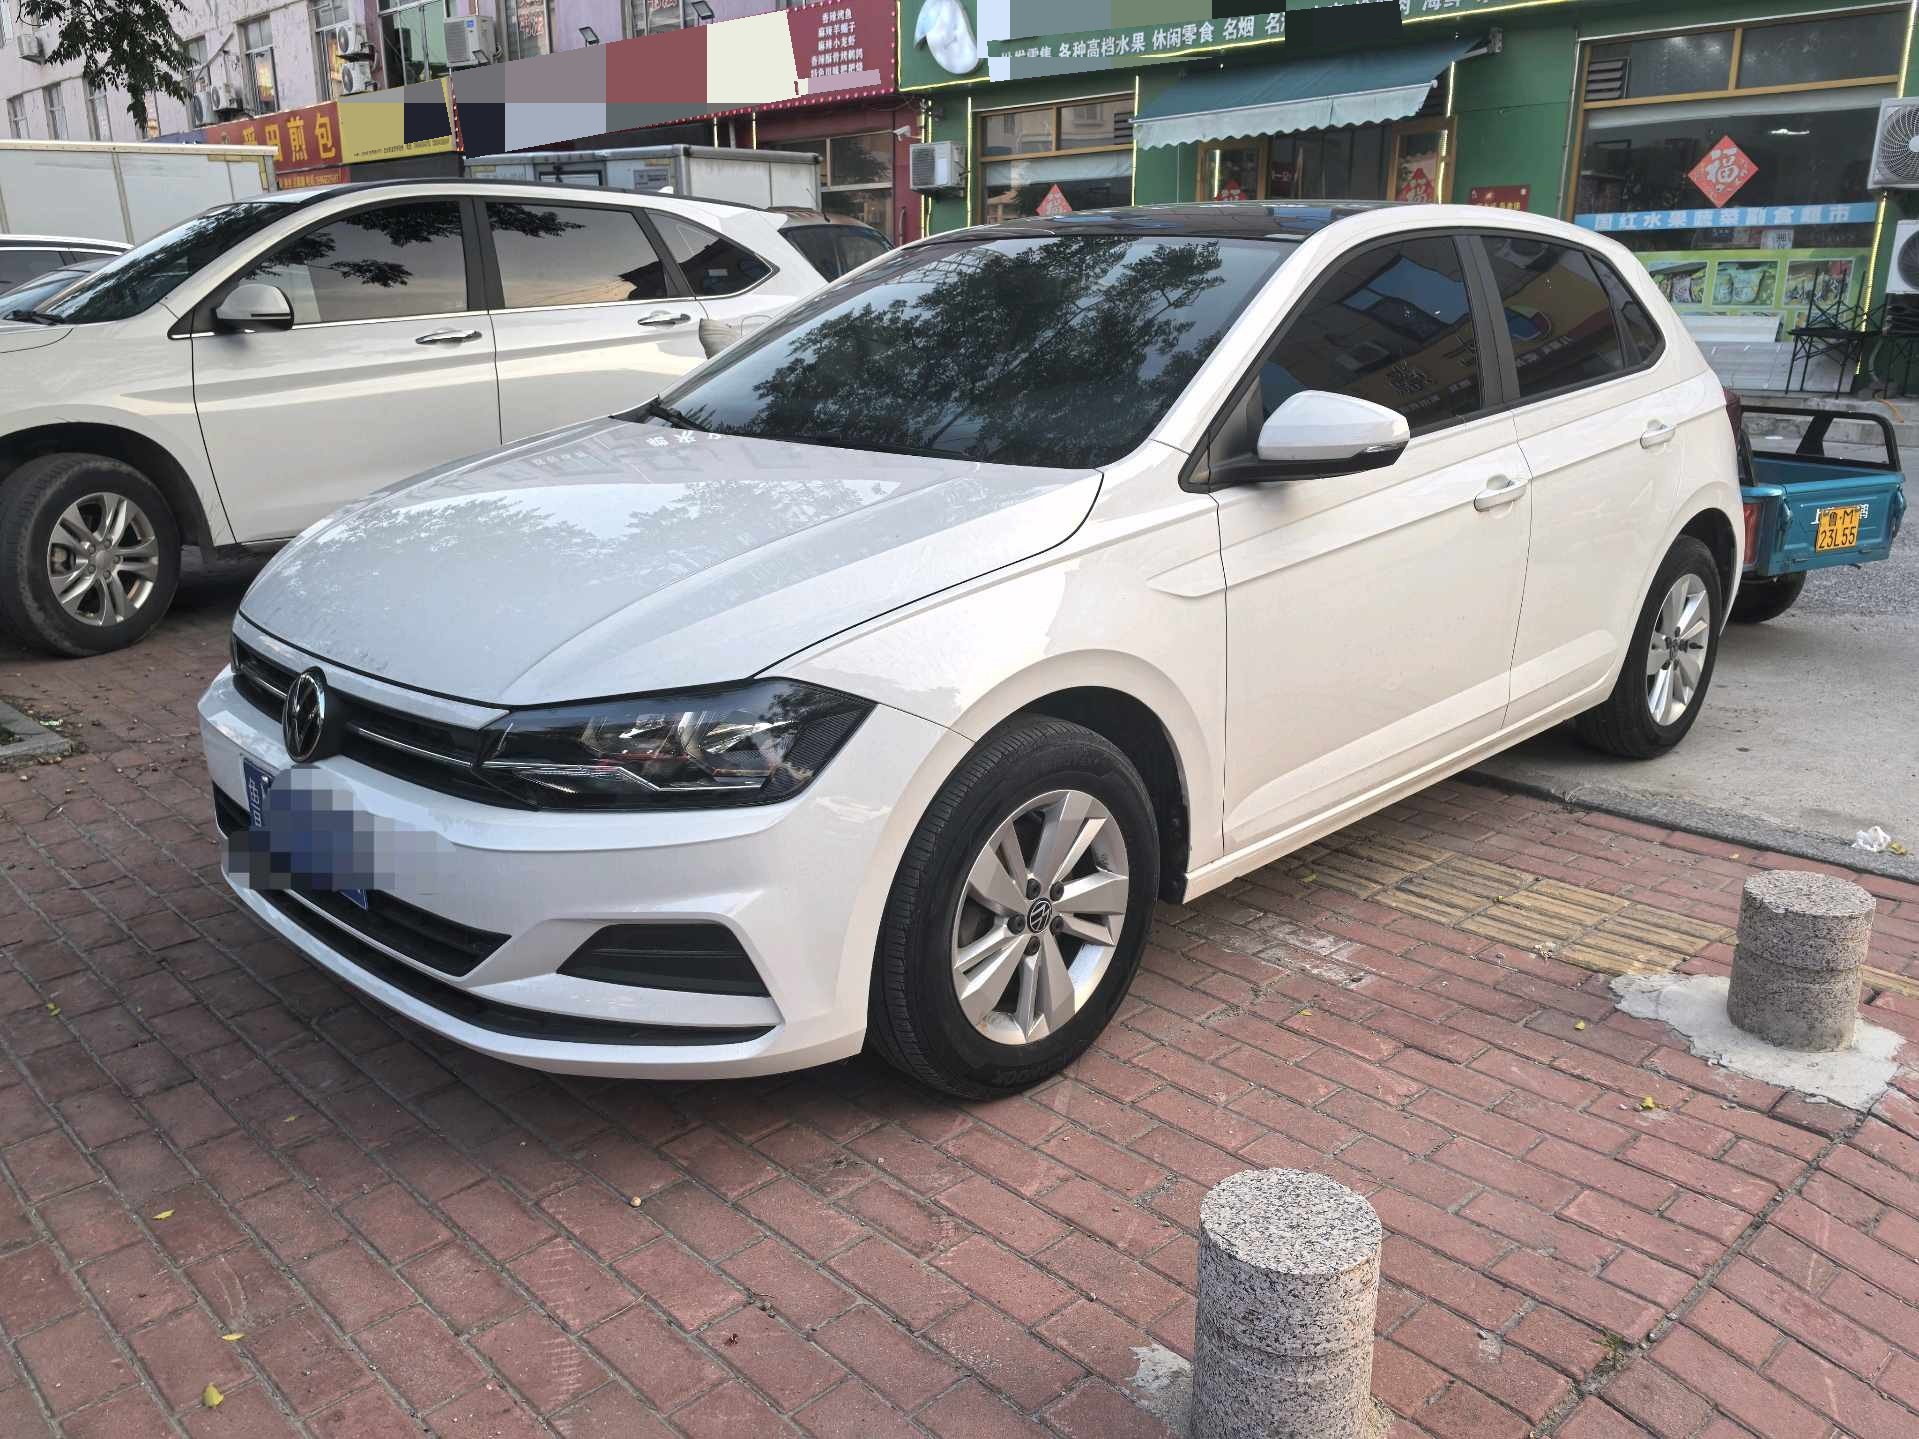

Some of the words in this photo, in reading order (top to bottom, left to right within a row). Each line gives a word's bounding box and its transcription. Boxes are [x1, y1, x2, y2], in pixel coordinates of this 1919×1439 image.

[818, 35, 855, 51] 麻辣小龙虾
[1058, 34, 1146, 57] 各种高档水果
[1152, 21, 1214, 50] 休闲零食
[1223, 16, 1255, 41] 名烟
[1704, 147, 1740, 184] 福
[1818, 526, 1857, 549] 23L55
